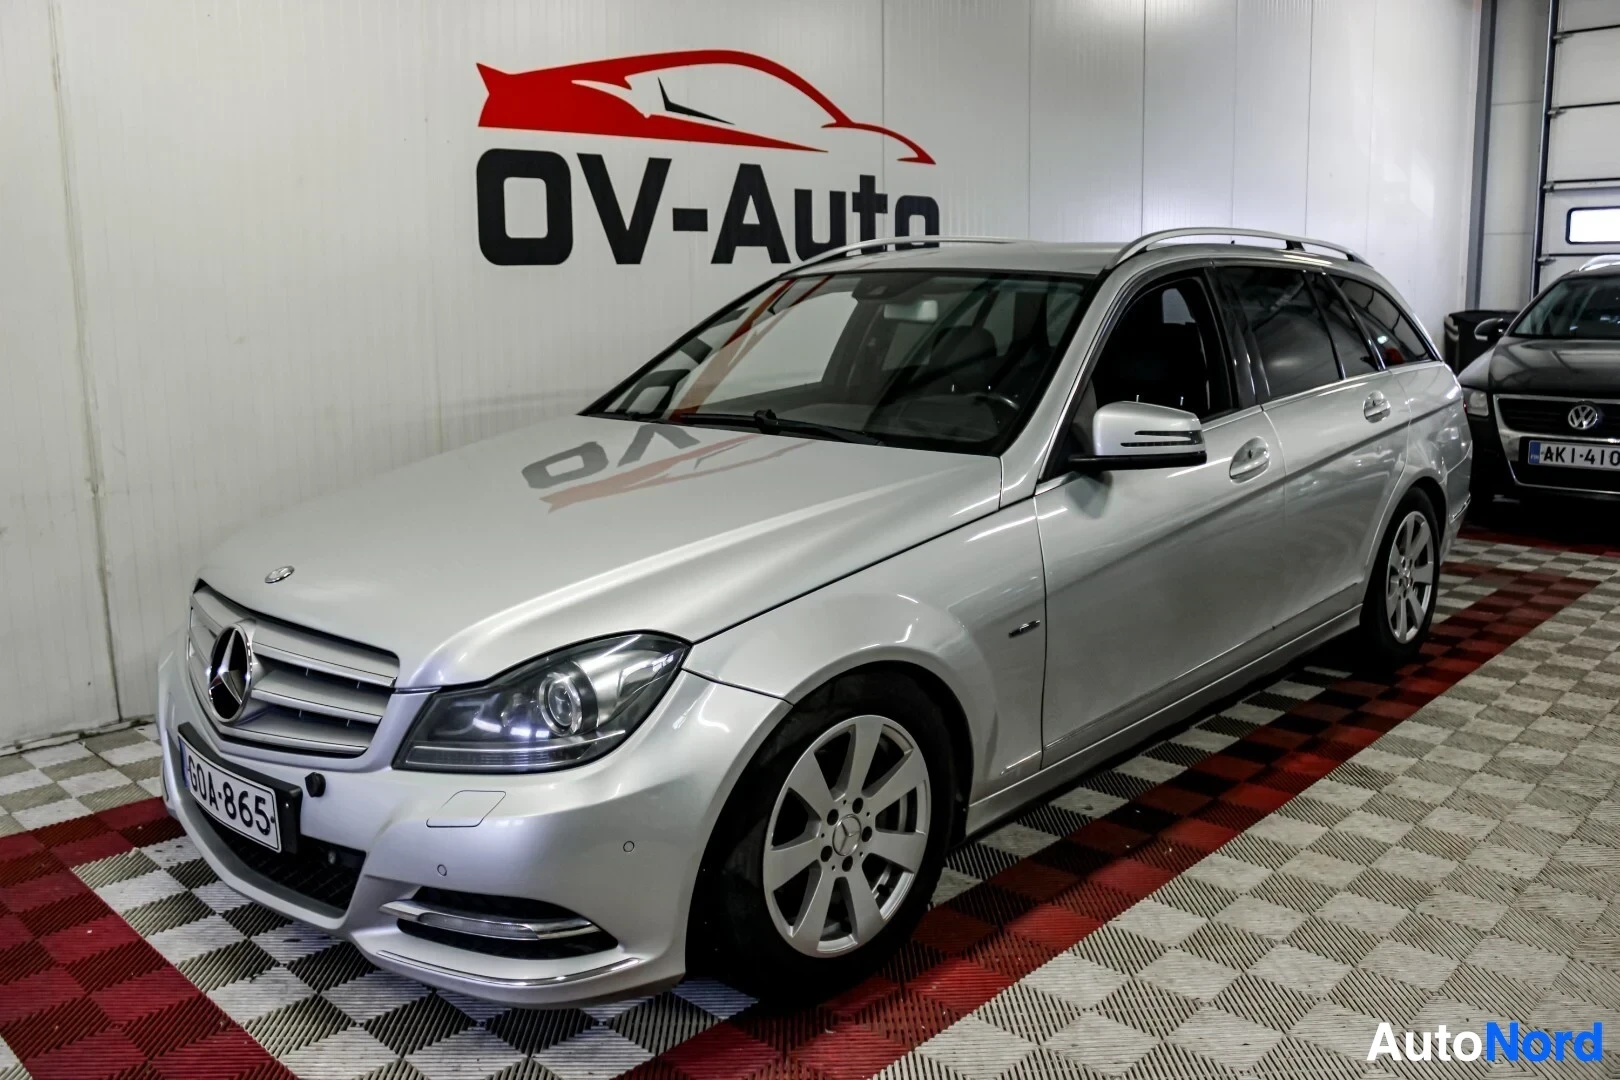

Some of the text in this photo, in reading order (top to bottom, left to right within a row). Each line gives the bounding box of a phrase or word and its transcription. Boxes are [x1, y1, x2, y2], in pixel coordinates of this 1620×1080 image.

[476, 148, 940, 265] OV-Auto
[1543, 446, 1620, 466] AKI-410
[188, 755, 271, 836] GOA-865
